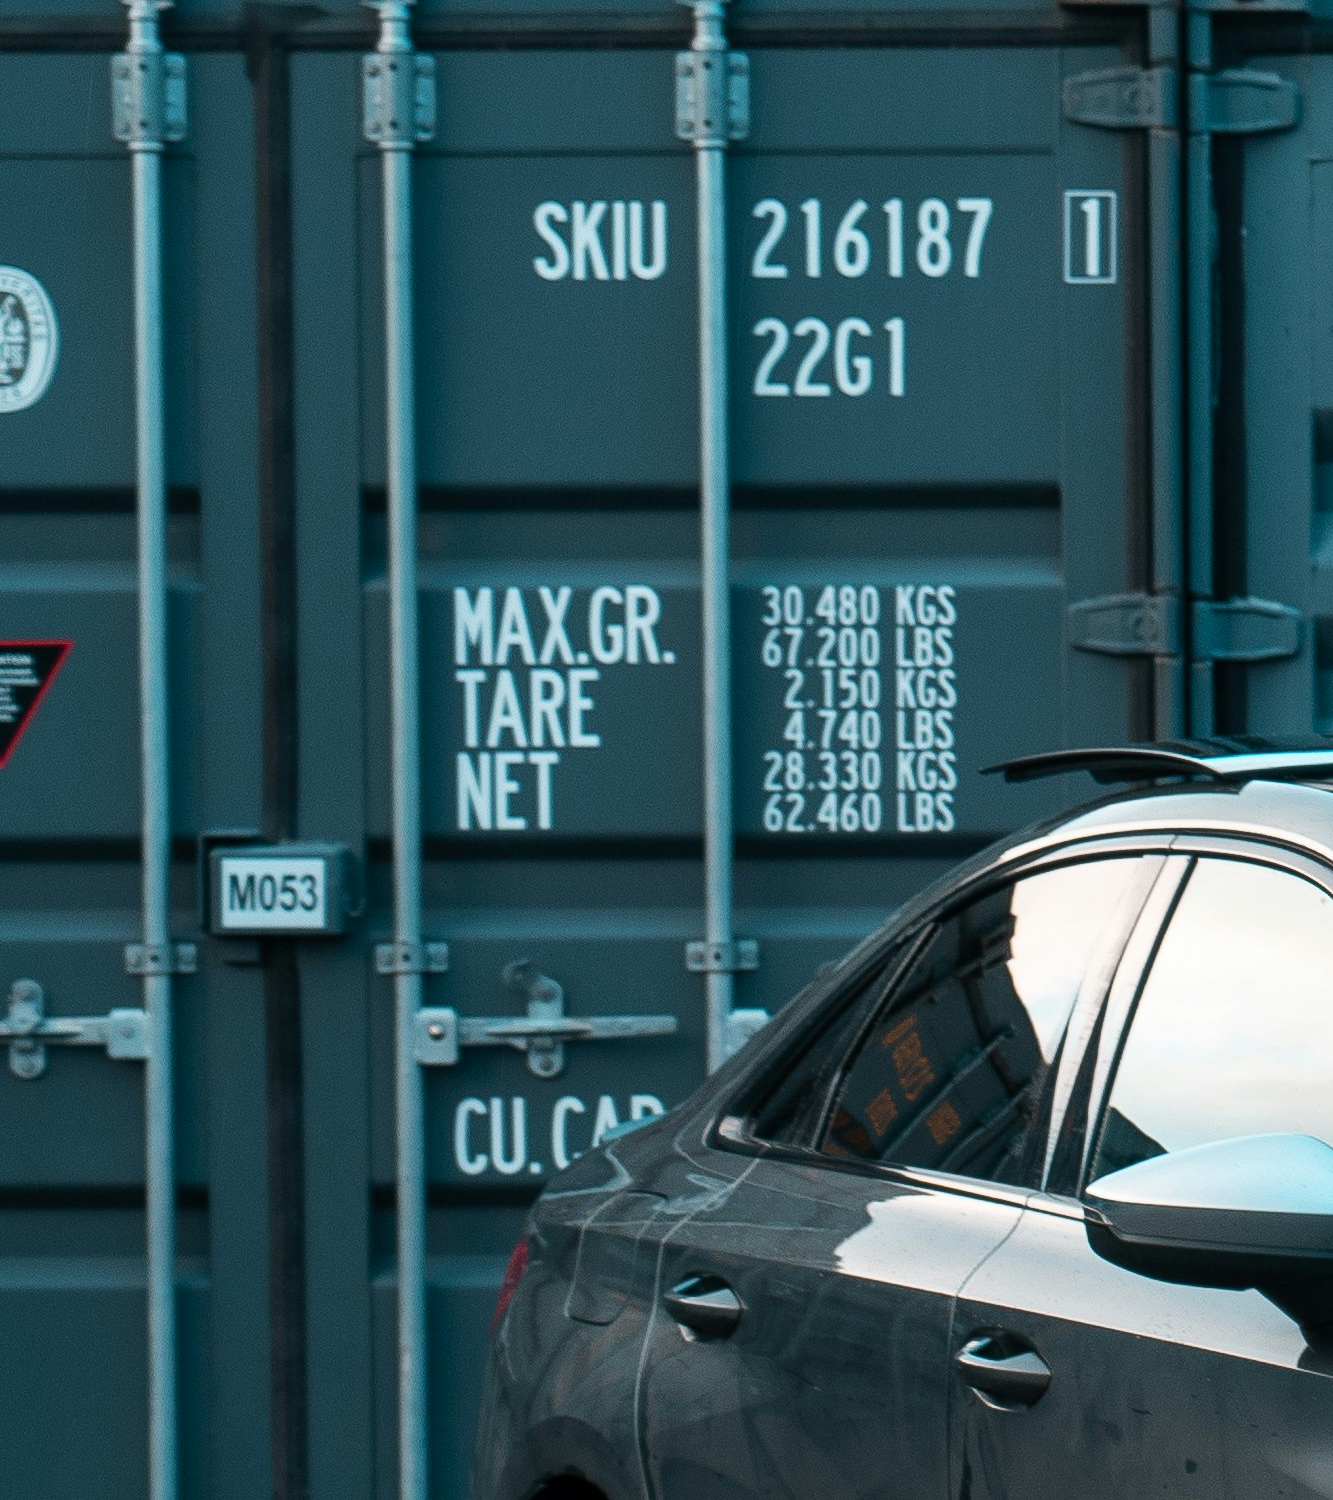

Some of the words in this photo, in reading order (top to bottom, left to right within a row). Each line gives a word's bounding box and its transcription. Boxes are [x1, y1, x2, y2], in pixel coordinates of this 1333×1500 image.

[534, 202, 665, 280] SKIU
[753, 199, 991, 277] 216187
[1082, 198, 1098, 277] 1
[755, 319, 903, 396] 22G1
[455, 586, 674, 665] MAX.GR.
[764, 585, 879, 626] 30.480
[896, 585, 955, 625] KGS
[763, 628, 879, 668] 67.200
[896, 628, 953, 668] LBS
[456, 669, 599, 747] TARE
[785, 669, 879, 709] 2.150
[896, 669, 956, 709] KGS
[784, 710, 880, 750] 4.740
[897, 710, 953, 750] LBS
[458, 752, 558, 830] NET
[764, 751, 880, 792] 28.330
[897, 751, 956, 790] KGS
[765, 793, 881, 832] 62.460
[898, 793, 953, 832] LBS
[230, 874, 317, 912] M053
